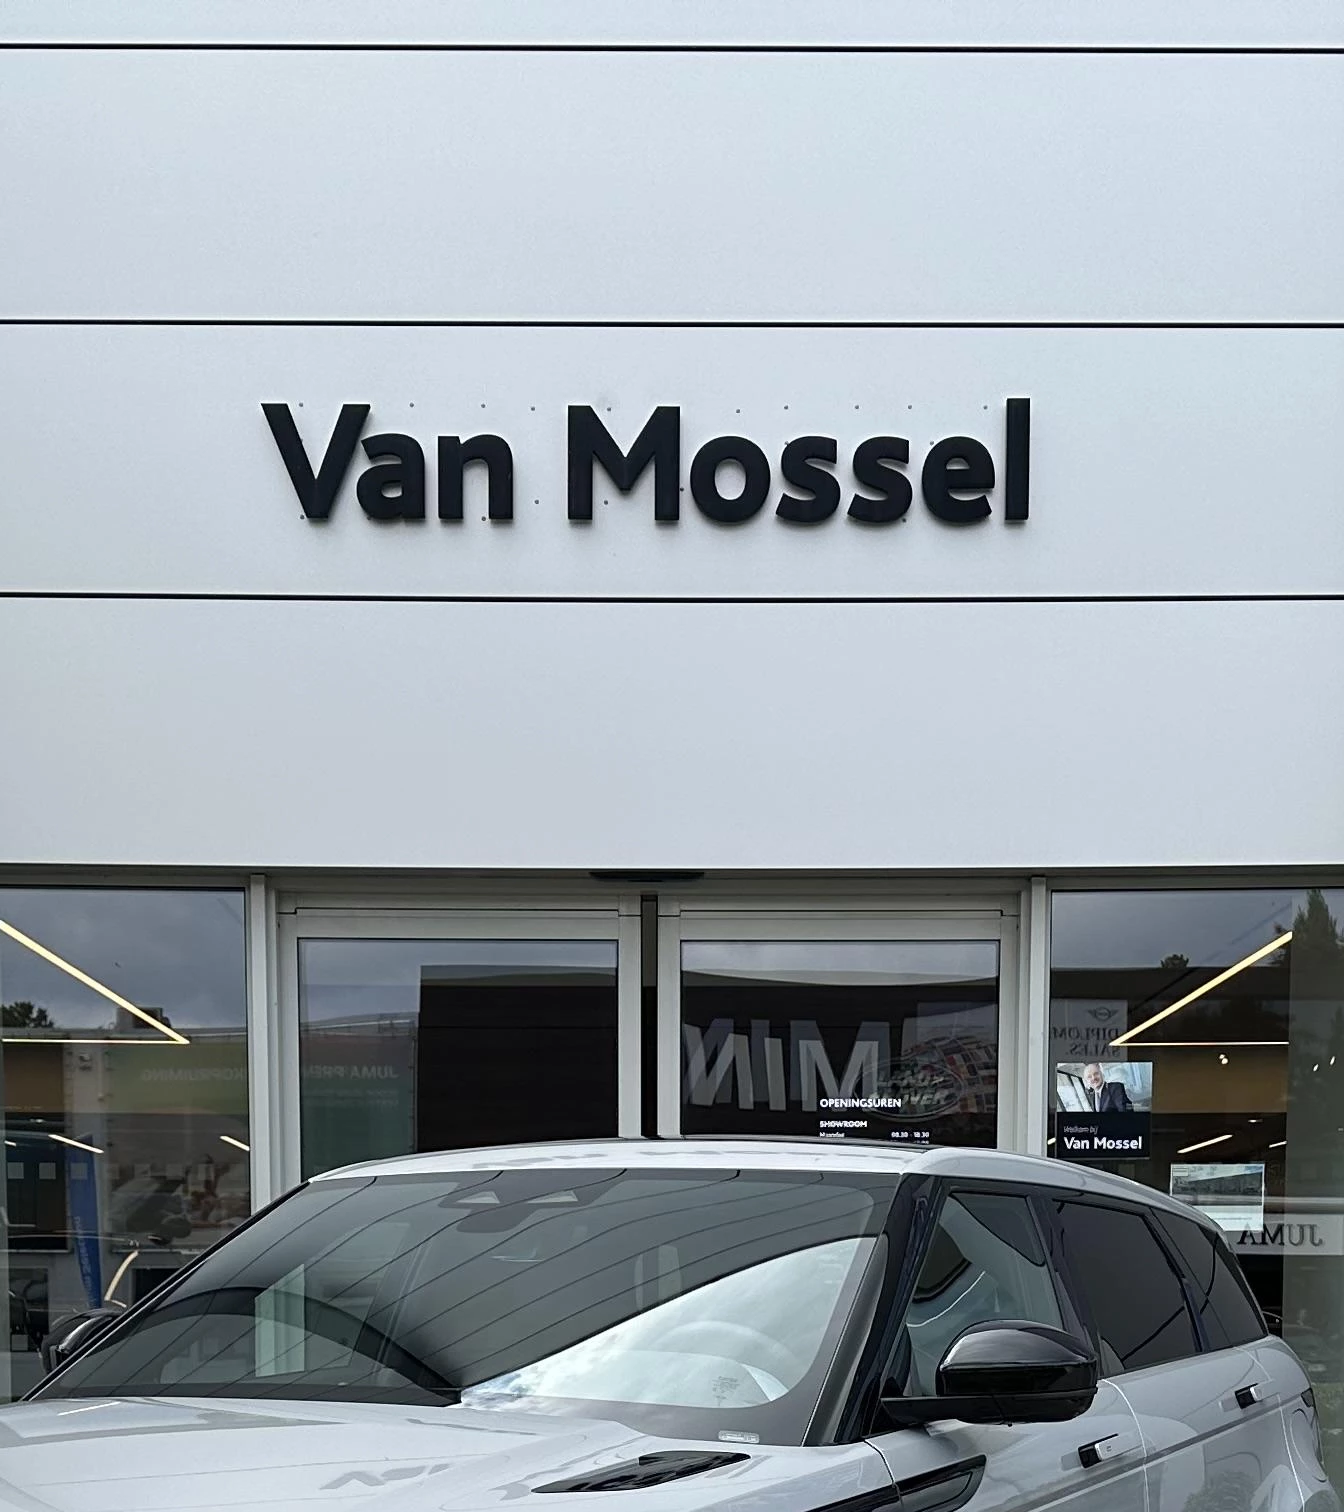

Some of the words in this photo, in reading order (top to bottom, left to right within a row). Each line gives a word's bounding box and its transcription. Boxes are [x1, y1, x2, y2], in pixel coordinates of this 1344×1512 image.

[260, 402, 515, 521] Van
[567, 397, 1032, 523] Mossel
[819, 1098, 902, 1108] OPENINGSUREN
[819, 1120, 868, 1128] SHOWROOM
[1063, 1136, 1090, 1150] Van
[1093, 1135, 1143, 1150] Mossel
